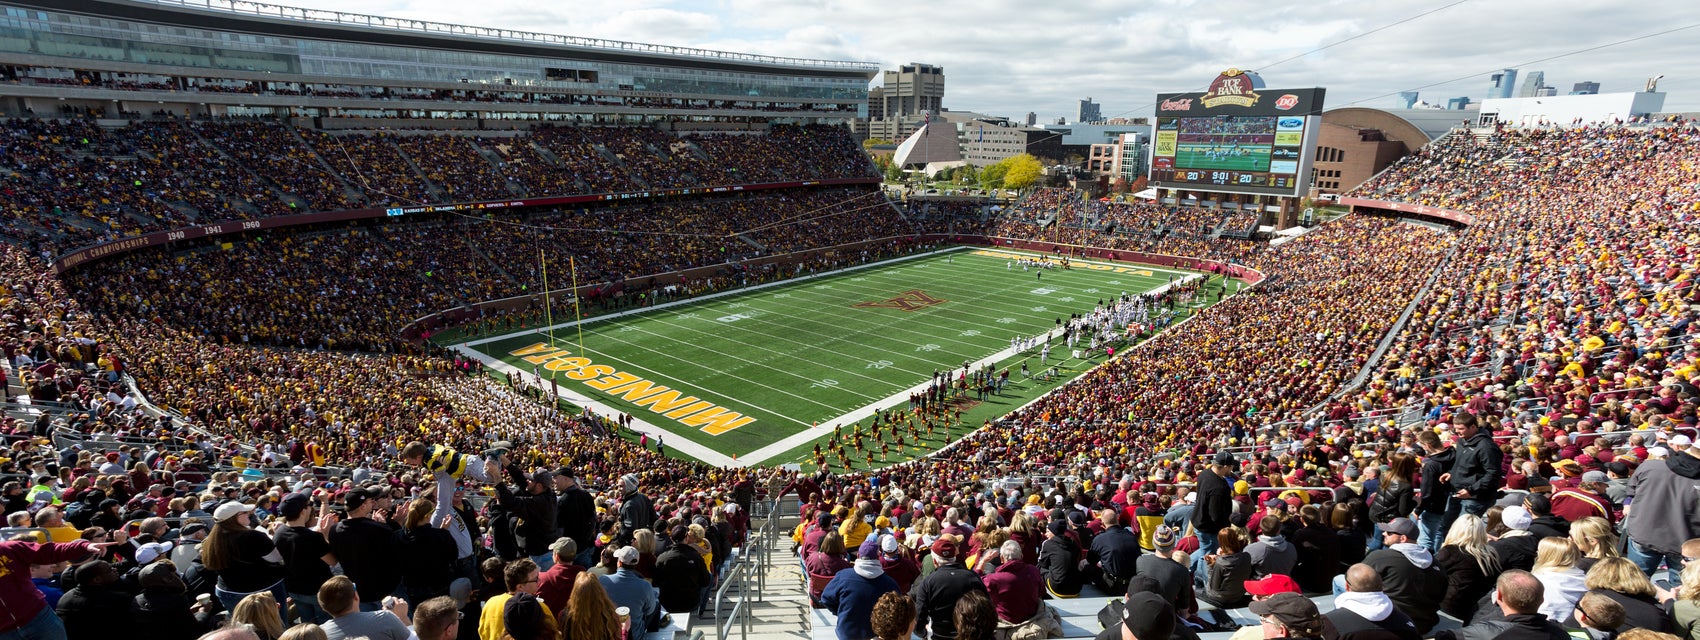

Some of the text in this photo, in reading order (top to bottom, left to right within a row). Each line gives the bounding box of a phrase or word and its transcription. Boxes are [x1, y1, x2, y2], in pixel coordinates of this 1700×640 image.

[1223, 78, 1240, 88] TCF
[1217, 86, 1243, 96] BANK
[1279, 96, 1296, 107] DQ
[1187, 171, 1198, 180] 20
[1212, 171, 1229, 180] 9:01
[1240, 174, 1252, 183] 20
[167, 220, 261, 241] 1940 1941 1960
[90, 237, 149, 257] CHAMPIONSHIPS
[508, 341, 758, 437] MINNESOTA
